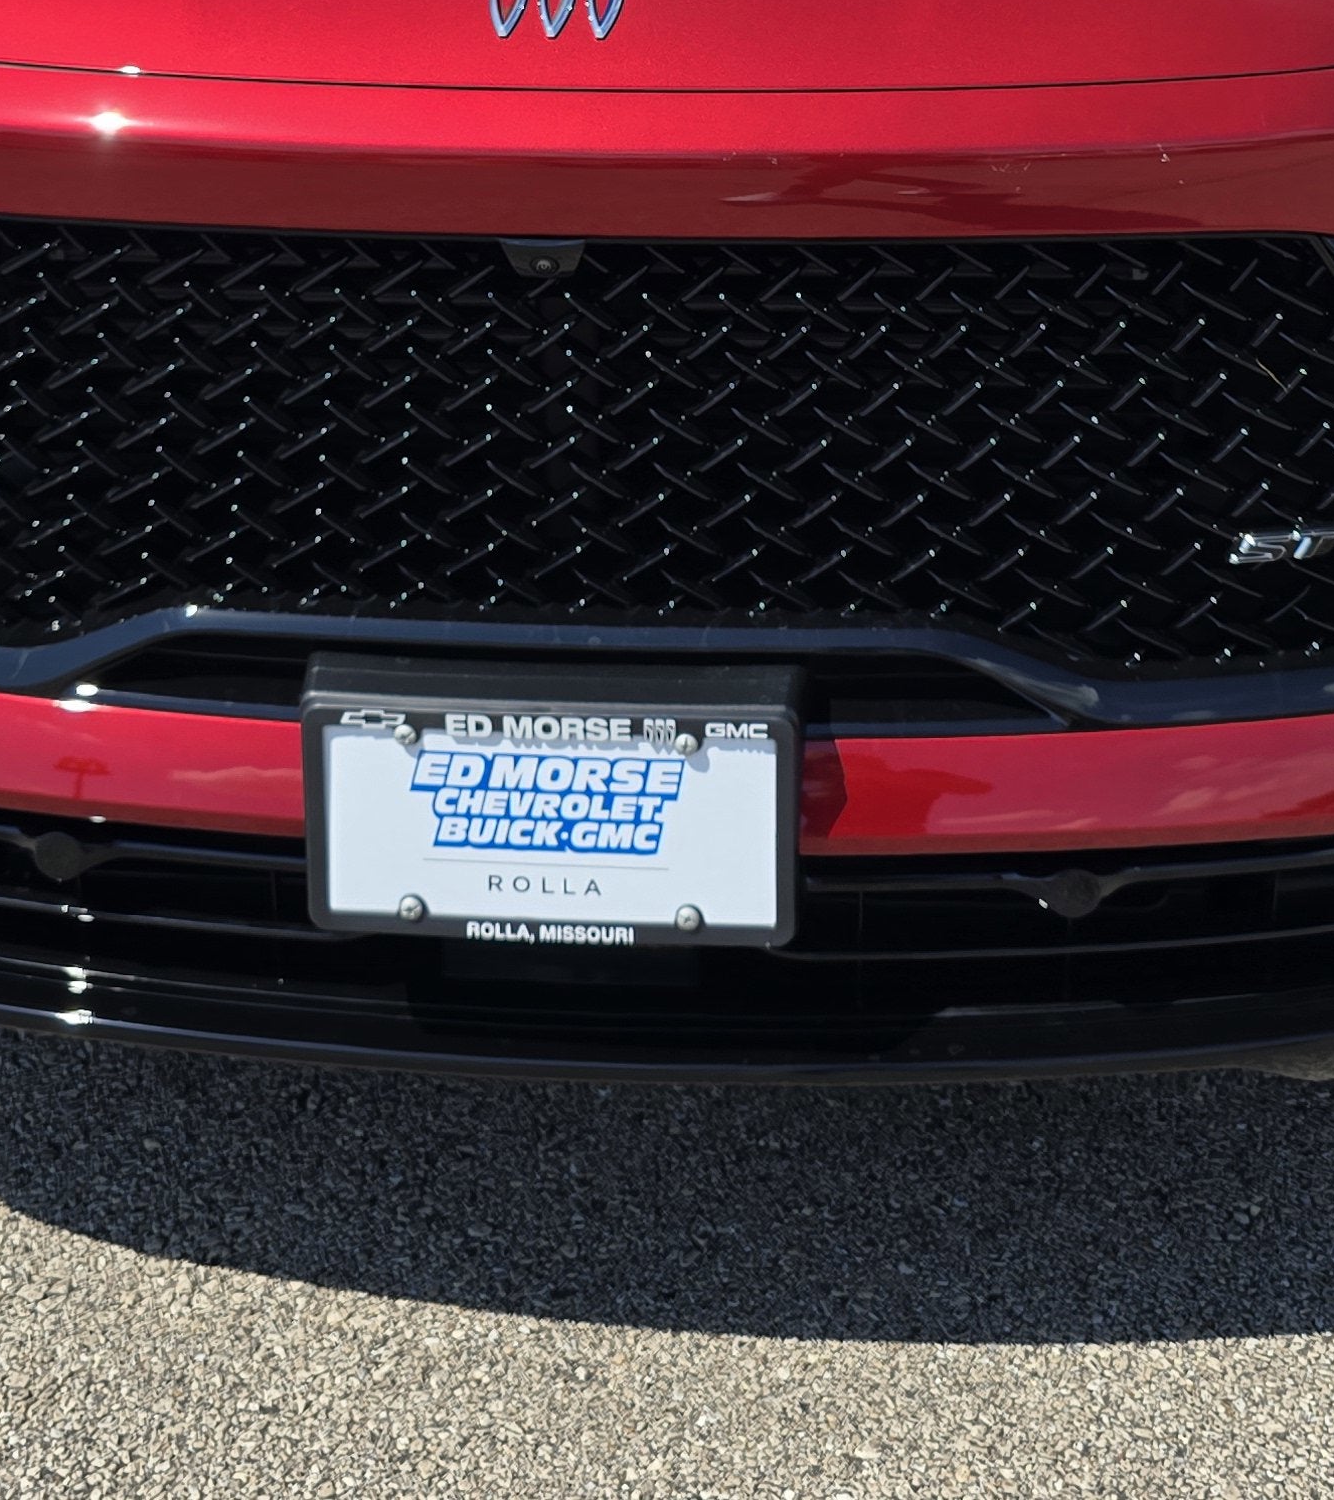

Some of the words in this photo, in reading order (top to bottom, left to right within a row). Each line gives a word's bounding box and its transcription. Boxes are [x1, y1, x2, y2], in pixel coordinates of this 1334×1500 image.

[445, 713, 493, 738] ED
[502, 715, 632, 742] MORSE
[704, 722, 769, 740] GMC
[413, 752, 486, 789] ED
[488, 754, 683, 794] MORSE
[487, 874, 602, 897] ROLLA
[466, 921, 535, 945] ROLLA,
[539, 924, 635, 946] MISSOURI
